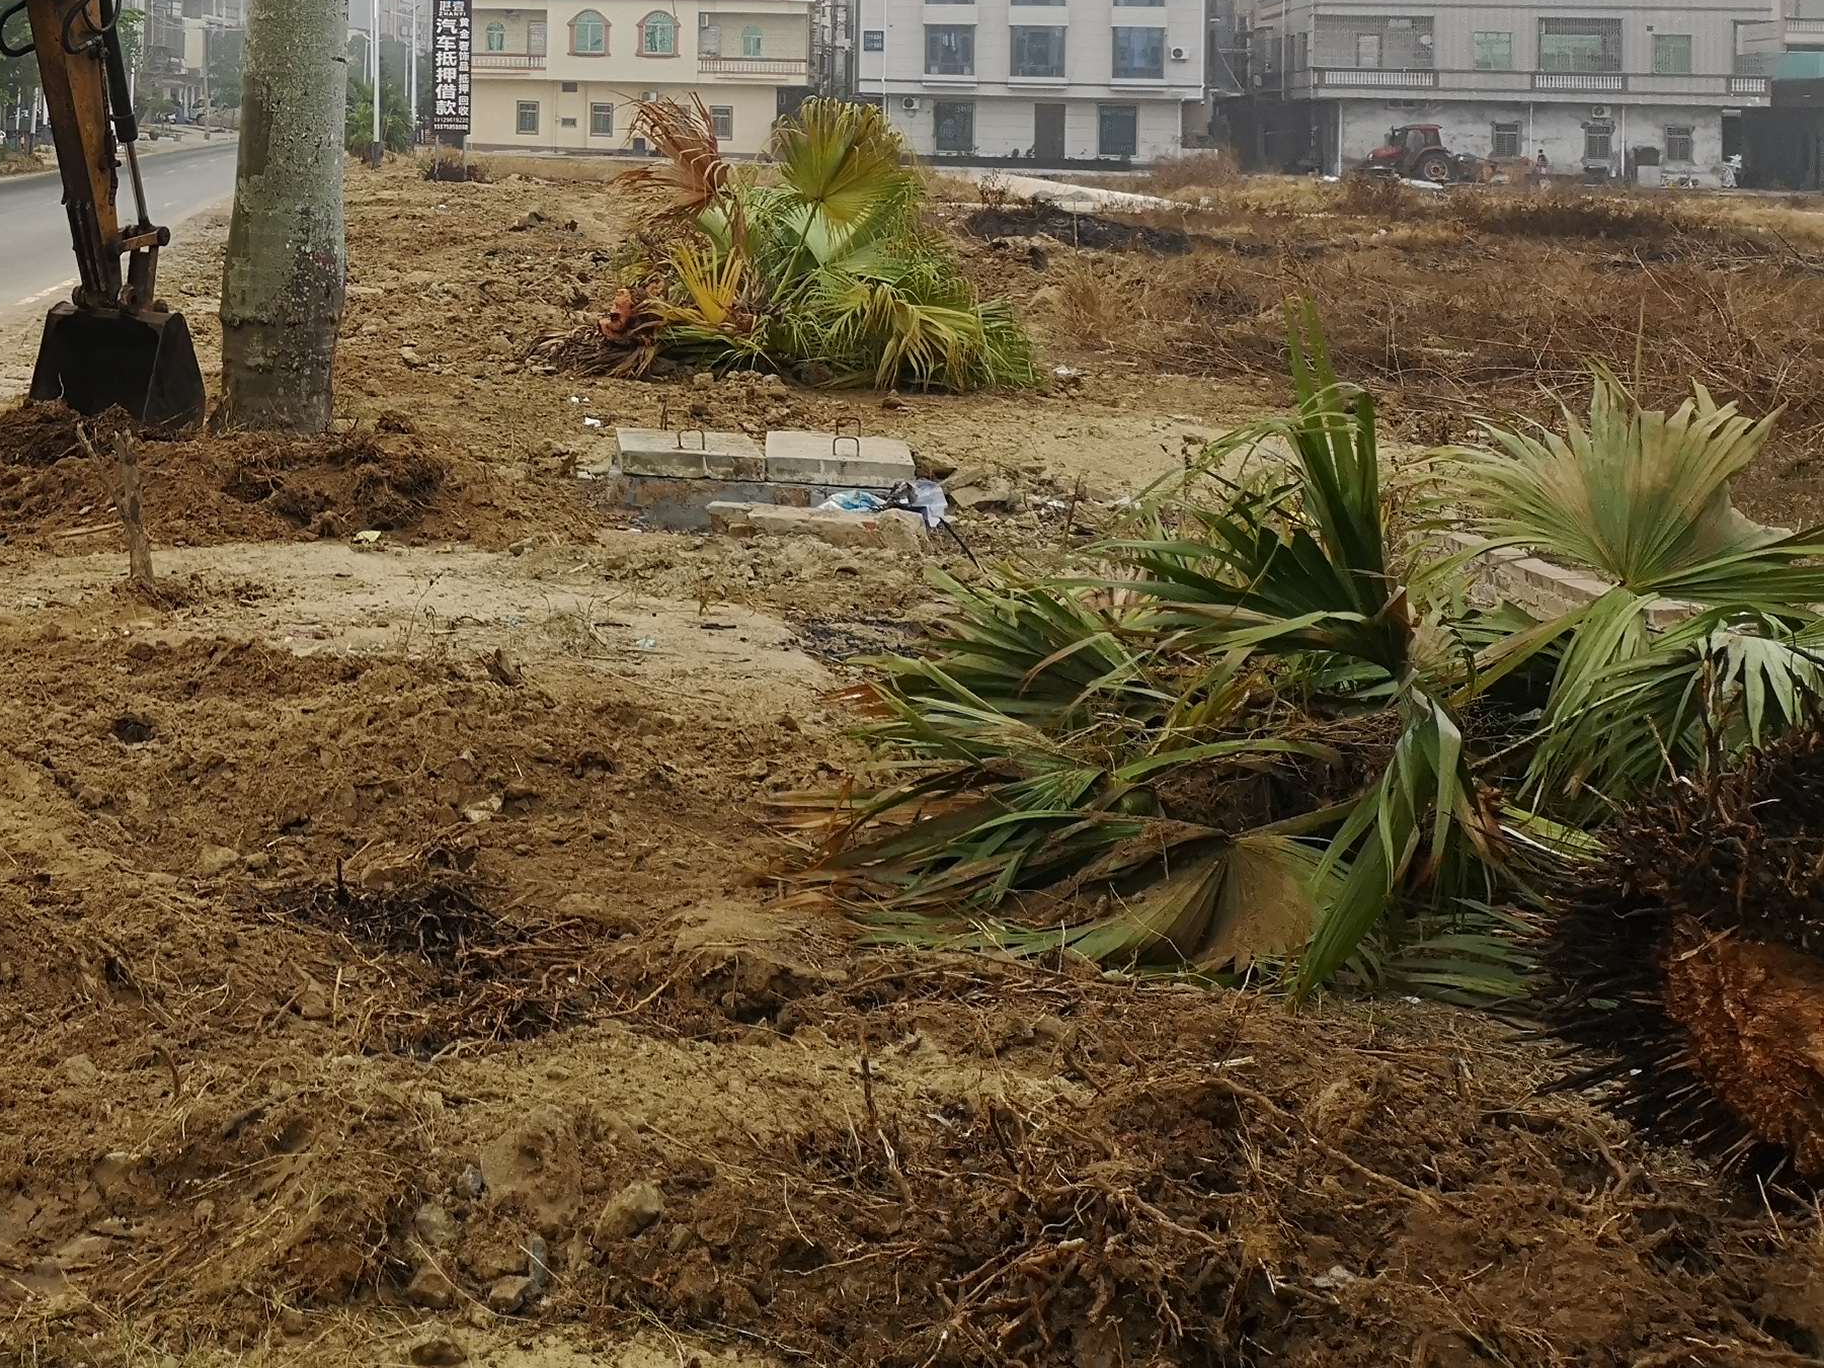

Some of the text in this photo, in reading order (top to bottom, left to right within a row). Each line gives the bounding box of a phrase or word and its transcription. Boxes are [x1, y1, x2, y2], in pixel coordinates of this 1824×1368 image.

[435, 17, 458, 116] 汽车抵押借款
